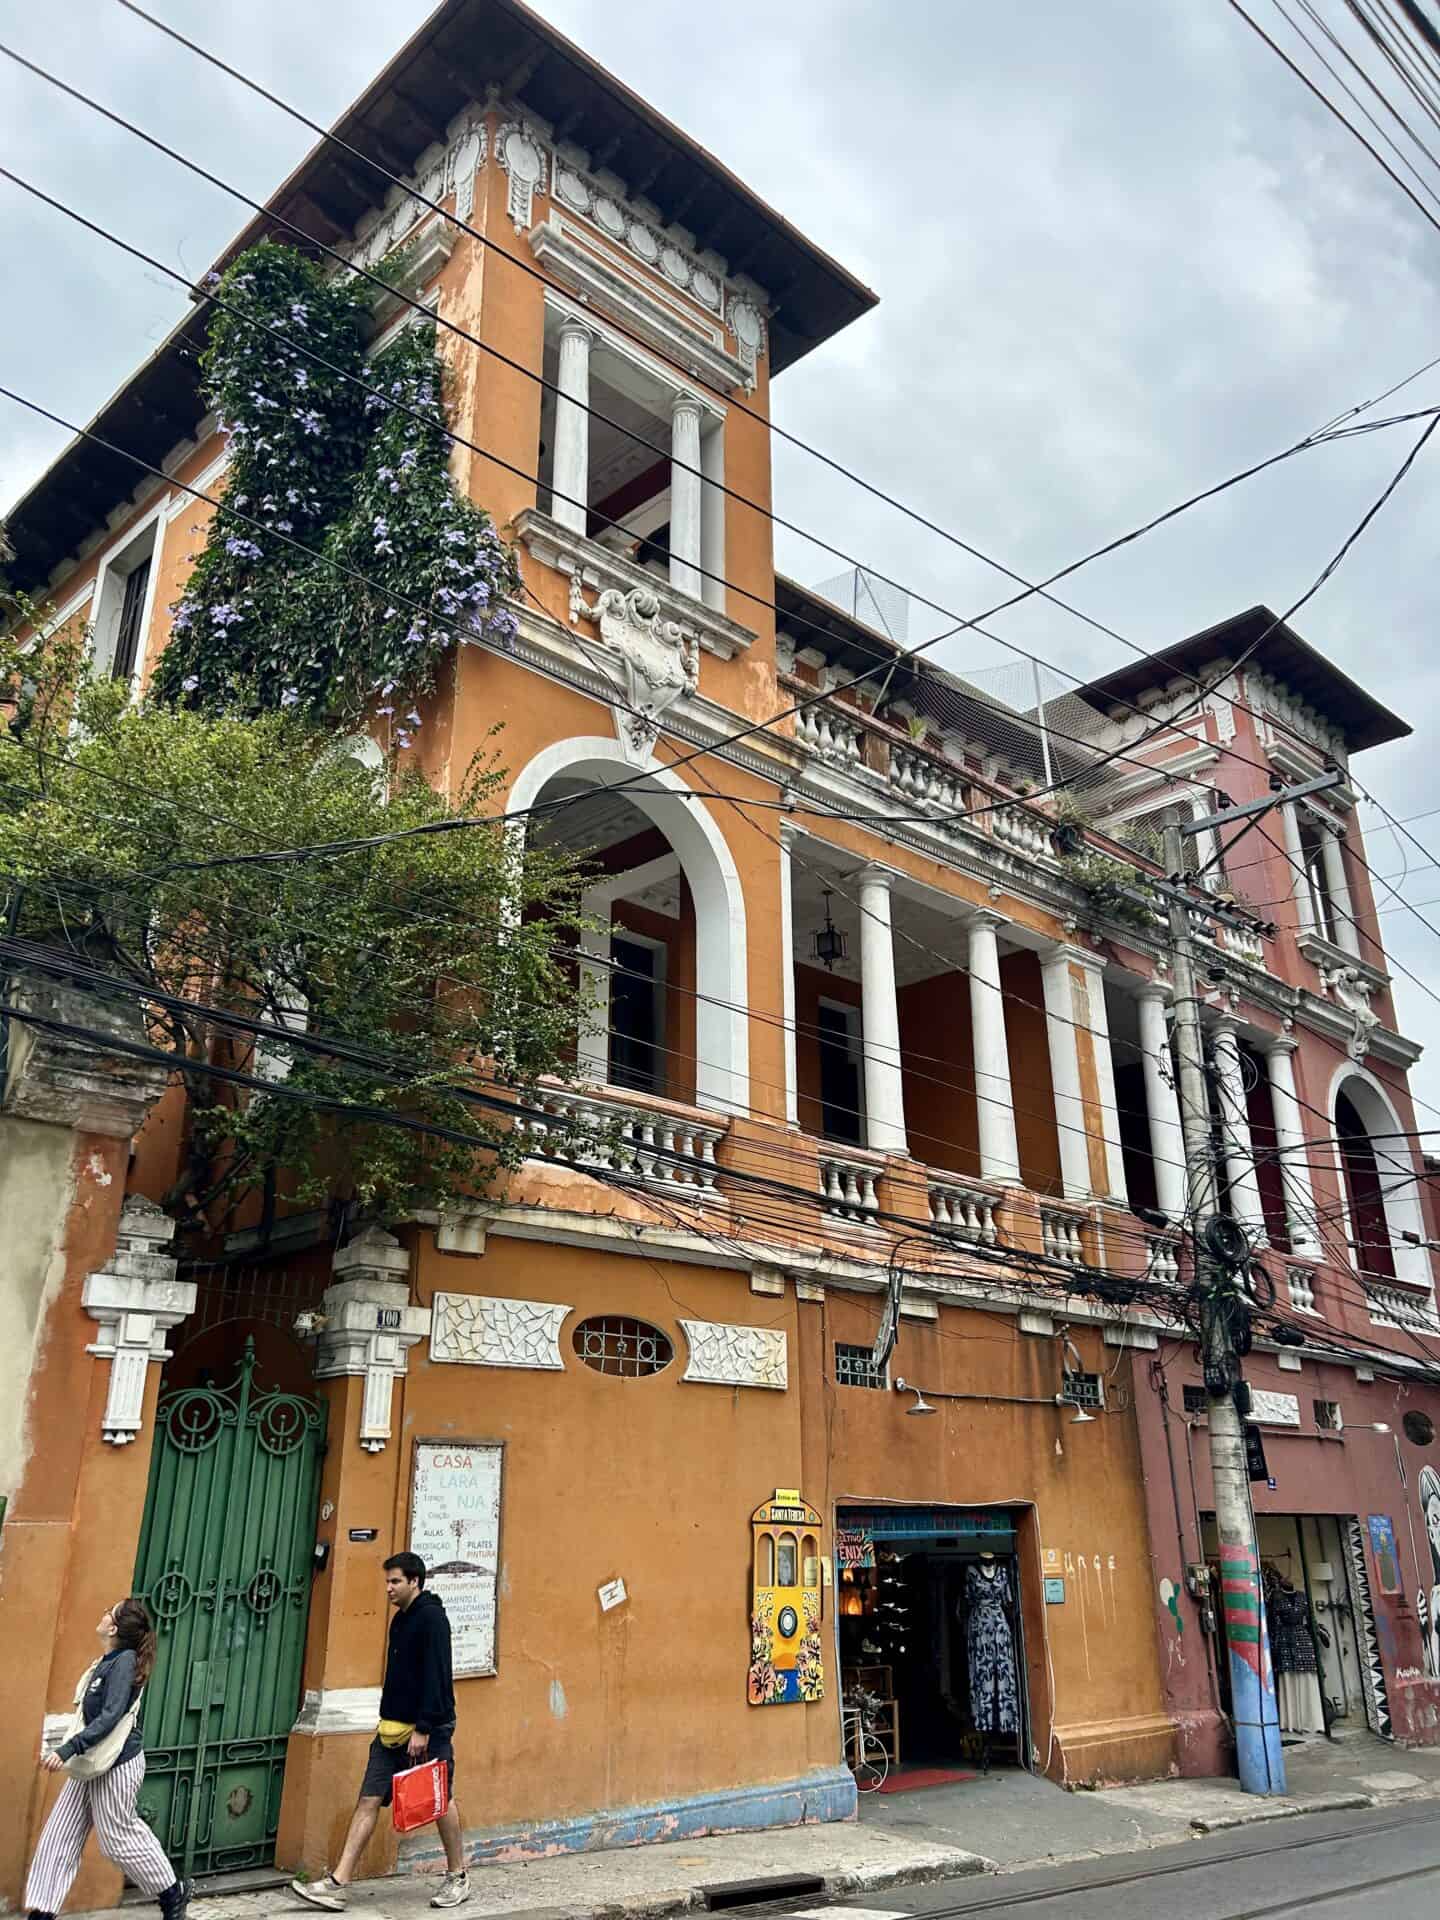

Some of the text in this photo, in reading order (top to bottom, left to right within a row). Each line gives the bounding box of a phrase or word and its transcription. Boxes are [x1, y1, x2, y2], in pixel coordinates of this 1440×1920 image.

[432, 1454, 472, 1469] CASA
[440, 1473, 478, 1488] LARA
[467, 1541, 493, 1549] PILATES
[419, 1552, 434, 1561] OGA
[466, 1551, 496, 1559] PINTURA
[839, 1543, 864, 1560] ÊNIX
